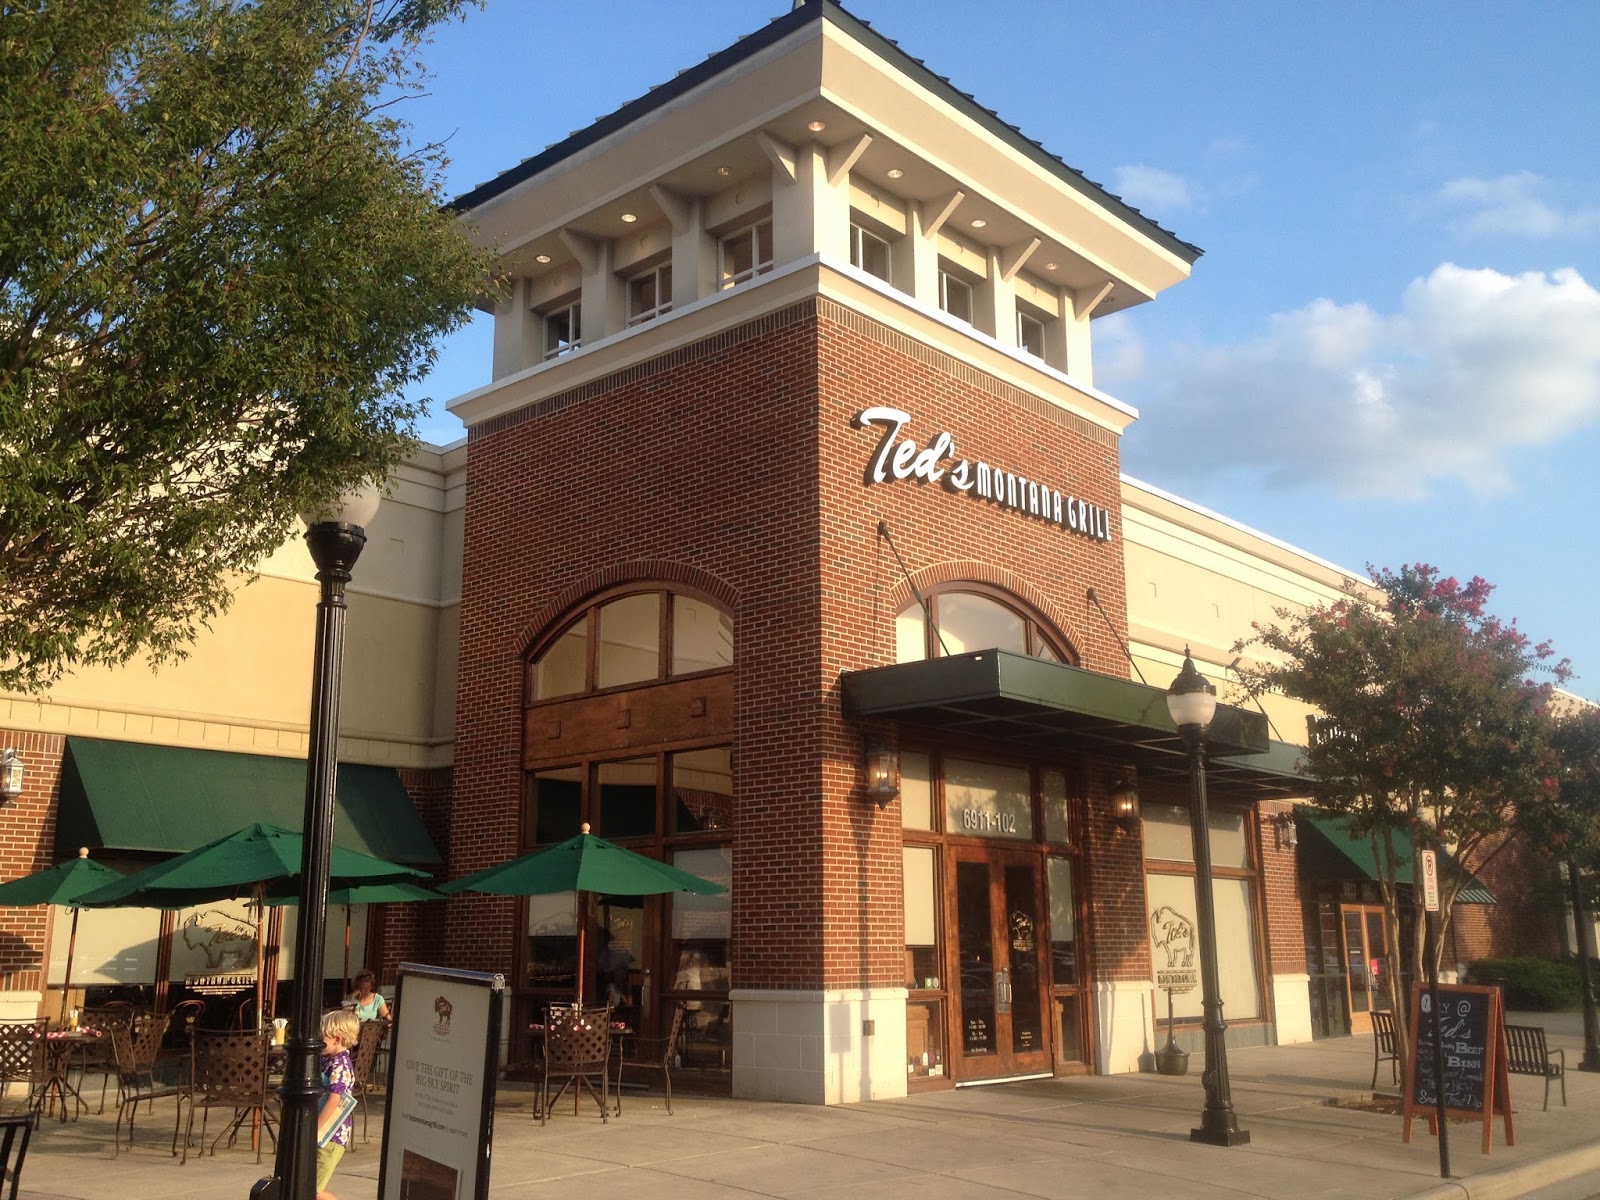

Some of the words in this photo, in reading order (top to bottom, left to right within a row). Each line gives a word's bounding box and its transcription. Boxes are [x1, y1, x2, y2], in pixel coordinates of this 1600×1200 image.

[859, 406, 974, 490] Ted's
[976, 461, 1062, 524] MONTANA
[1067, 495, 1113, 542] GRILL
[963, 808, 1016, 833] 6911-102
[405, 1059, 420, 1072] GIVE
[421, 1062, 433, 1076] THE
[434, 1066, 449, 1079] GIFT
[449, 1069, 459, 1082] OF
[459, 1071, 474, 1085] THE
[416, 1074, 427, 1087] BIG
[427, 1077, 440, 1090] SKY
[440, 1080, 461, 1095] SPIRIT
